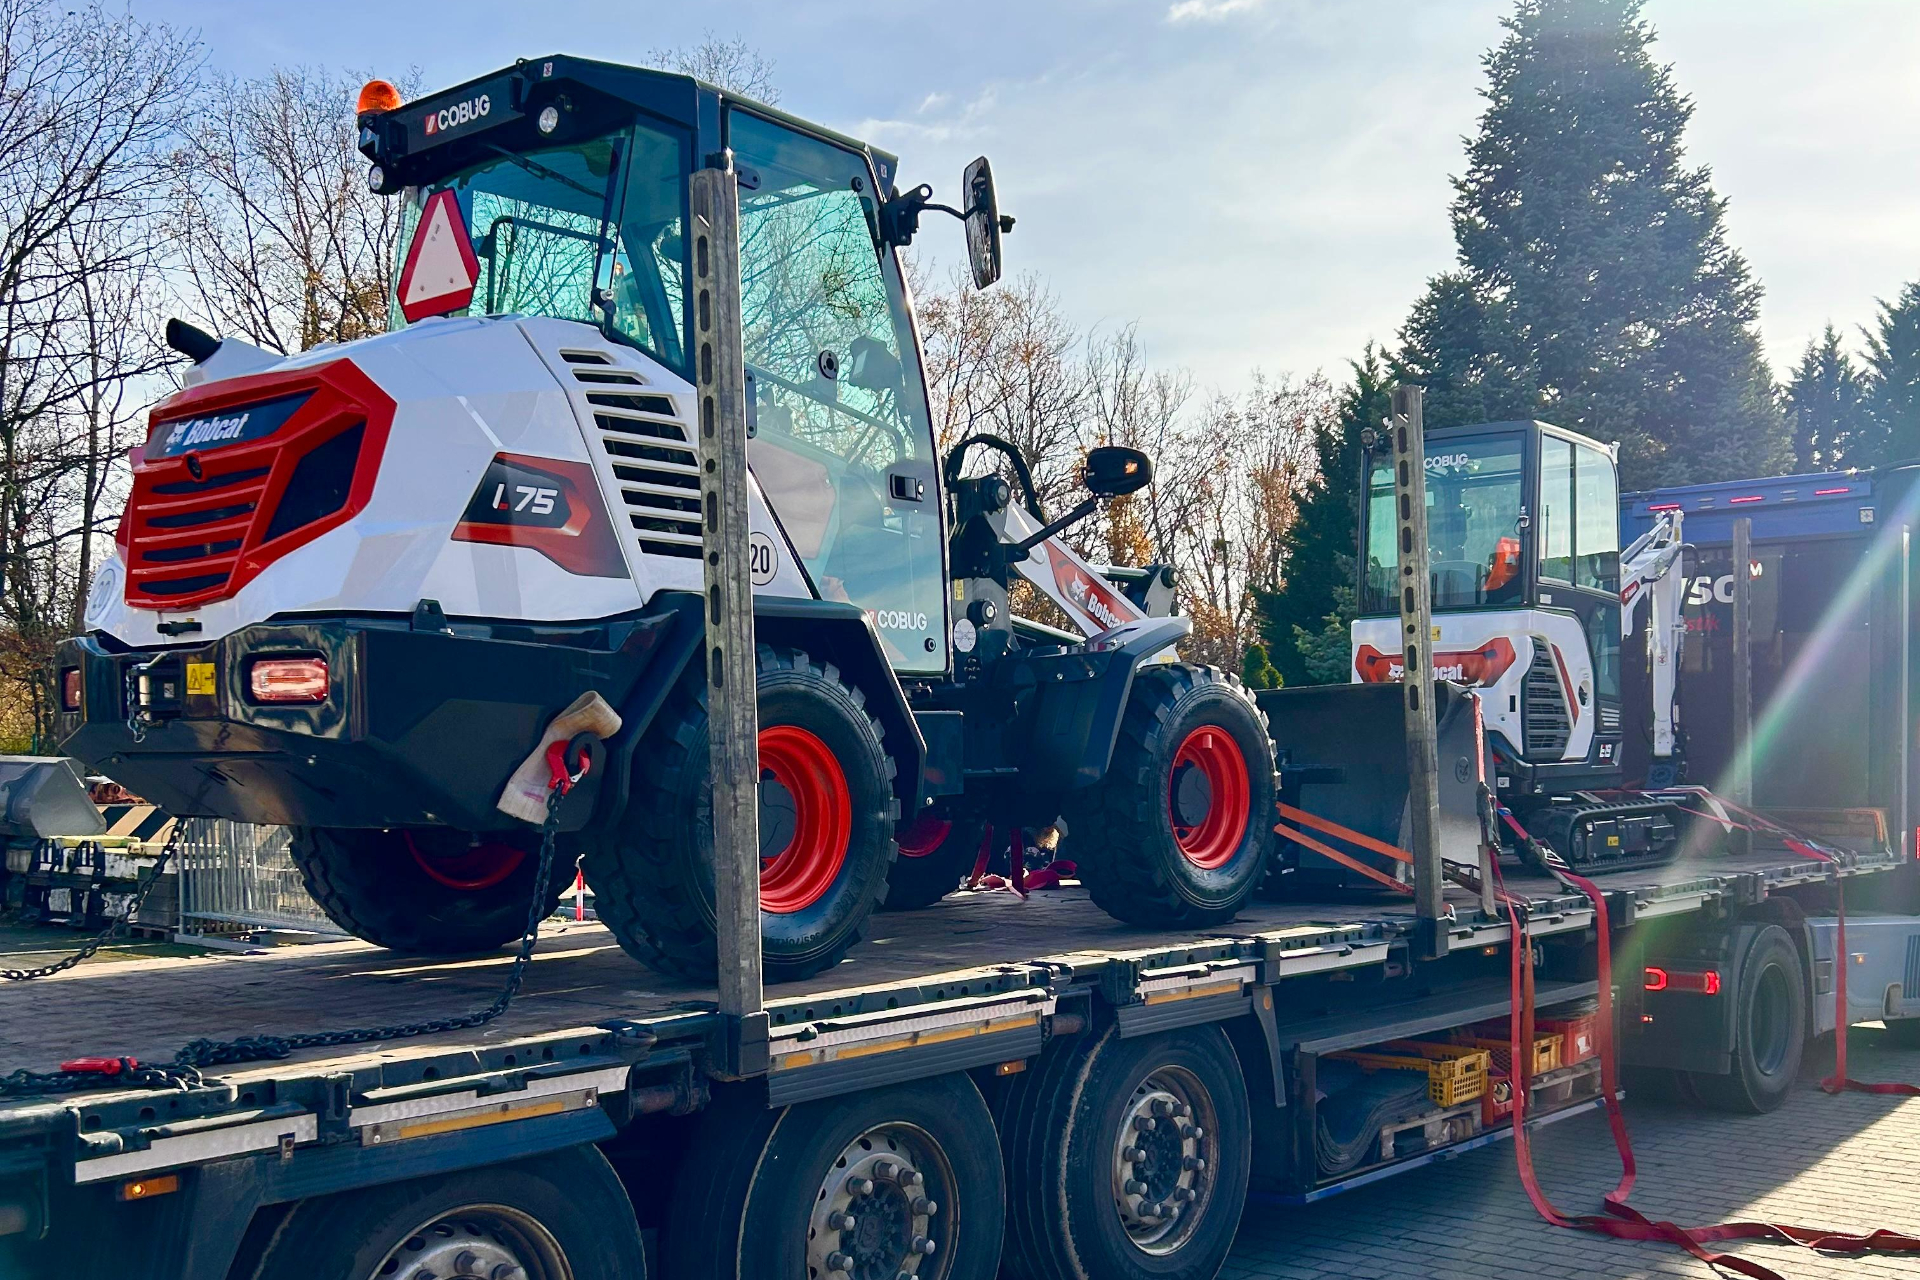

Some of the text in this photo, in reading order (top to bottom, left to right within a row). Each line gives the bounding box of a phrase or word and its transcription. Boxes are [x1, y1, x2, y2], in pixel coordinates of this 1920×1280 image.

[437, 94, 491, 131] COBUG
[182, 413, 250, 446] Bobcat
[1423, 453, 1469, 469] COBUG
[750, 543, 770, 574] 20
[877, 609, 929, 631] COBUG
[1087, 593, 1127, 629] Bobca
